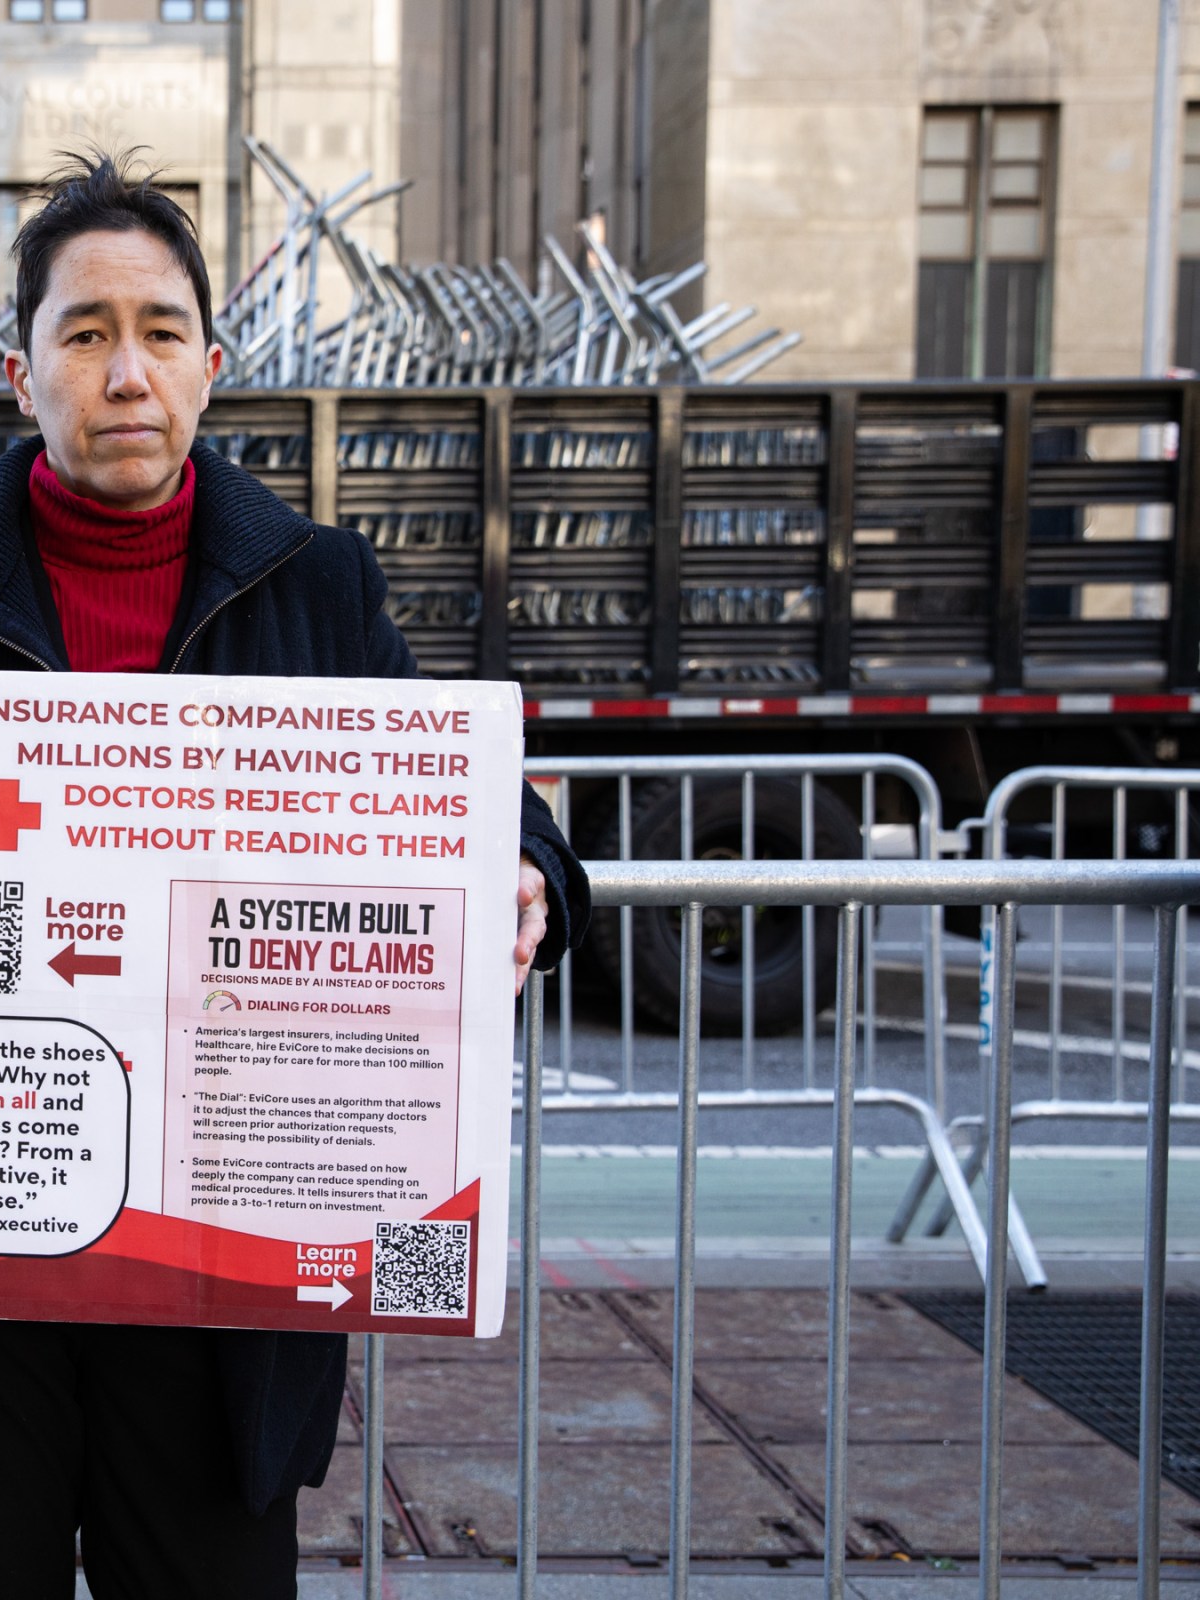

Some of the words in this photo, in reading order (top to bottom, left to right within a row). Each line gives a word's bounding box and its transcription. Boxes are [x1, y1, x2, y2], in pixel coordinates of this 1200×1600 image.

[179, 704, 375, 732] COMPANIES
[385, 709, 470, 734] SAVE
[18, 742, 172, 769] MILLIONS
[183, 747, 225, 770] BY
[235, 748, 361, 774] HAVING
[371, 752, 469, 777] THEIR
[64, 784, 215, 810] DOCTORS
[225, 789, 341, 813] REJECT
[349, 792, 468, 817] CLAIMS
[66, 825, 216, 851] WITHOUT
[225, 830, 367, 856] READING
[377, 834, 465, 858] THEM
[46, 897, 125, 920] Learn
[210, 897, 230, 929] A
[239, 898, 351, 933] SYSTEM
[359, 902, 435, 935] BUILT
[47, 922, 124, 941] more
[208, 936, 241, 968] TO
[249, 938, 323, 971] DENY
[330, 941, 434, 975] CLAIMS
[201, 974, 259, 984] DECISIONS
[261, 976, 293, 986] MADE
[295, 977, 310, 986] BY
[312, 978, 323, 987] AI
[326, 978, 372, 988] INSTEAD
[375, 980, 389, 989] OF
[392, 980, 445, 990] DOCTORS
[248, 1000, 299, 1012] DIALING
[302, 1002, 328, 1013] FOR
[331, 1003, 391, 1015] DOLLARS
[249, 1028, 285, 1039] largest
[287, 1029, 333, 1041] insurers,
[335, 1031, 383, 1043] including
[385, 1033, 419, 1042] United
[0, 1040, 36, 1059] the
[42, 1042, 105, 1062] shoes
[195, 1040, 254, 1051] Healthcare,
[256, 1042, 277, 1051] hire
[279, 1042, 319, 1052] EviCore
[321, 1045, 332, 1053] to
[334, 1045, 363, 1054] make
[364, 1045, 414, 1055] decisions
[53, 1070, 90, 1086] not
[11, 1091, 36, 1109] all
[43, 1093, 83, 1111] and
[249, 1093, 289, 1103] EviCore
[291, 1097, 316, 1105] uses
[333, 1097, 383, 1108] algorithm
[385, 1098, 405, 1107] that
[408, 1099, 441, 1109] allows
[193, 1105, 200, 1114] it
[203, 1106, 213, 1114] to
[215, 1106, 247, 1116] adjust
[249, 1107, 266, 1116] the
[268, 1108, 312, 1118] chances
[314, 1109, 335, 1119] that
[337, 1112, 385, 1122] company
[387, 1112, 427, 1121] doctors
[18, 1121, 79, 1136] come
[193, 1118, 210, 1127] will
[212, 1120, 248, 1128] screen
[250, 1120, 275, 1130] prior
[277, 1121, 346, 1132] authorization
[348, 1125, 396, 1135] requests,
[193, 1131, 246, 1143] increasing
[248, 1133, 265, 1142] the
[267, 1134, 320, 1146] possibility
[322, 1136, 334, 1145] of
[335, 1137, 375, 1146] denials.
[17, 1141, 73, 1161] From
[80, 1149, 91, 1161] a
[192, 1157, 220, 1166] Some
[223, 1158, 263, 1168] EviCore
[265, 1161, 315, 1171] contracts
[336, 1163, 368, 1172] based
[385, 1164, 407, 1173] how
[52, 1167, 67, 1185] it
[192, 1170, 226, 1181] deeply
[228, 1171, 245, 1180] the
[247, 1174, 294, 1185] company
[318, 1176, 354, 1185] reduce
[356, 1177, 404, 1189] spending
[191, 1183, 231, 1192] medical
[233, 1186, 295, 1195] procedures.
[298, 1187, 305, 1196] It
[307, 1188, 329, 1197] tells
[331, 1188, 374, 1198] insurers
[376, 1190, 397, 1199] that
[400, 1190, 406, 1199] it
[191, 1196, 230, 1206] provide
[240, 1198, 272, 1207] 3-to-1
[274, 1200, 307, 1209] return
[324, 1201, 385, 1212] investment.
[297, 1244, 357, 1261] Learn
[298, 1262, 355, 1277] more
